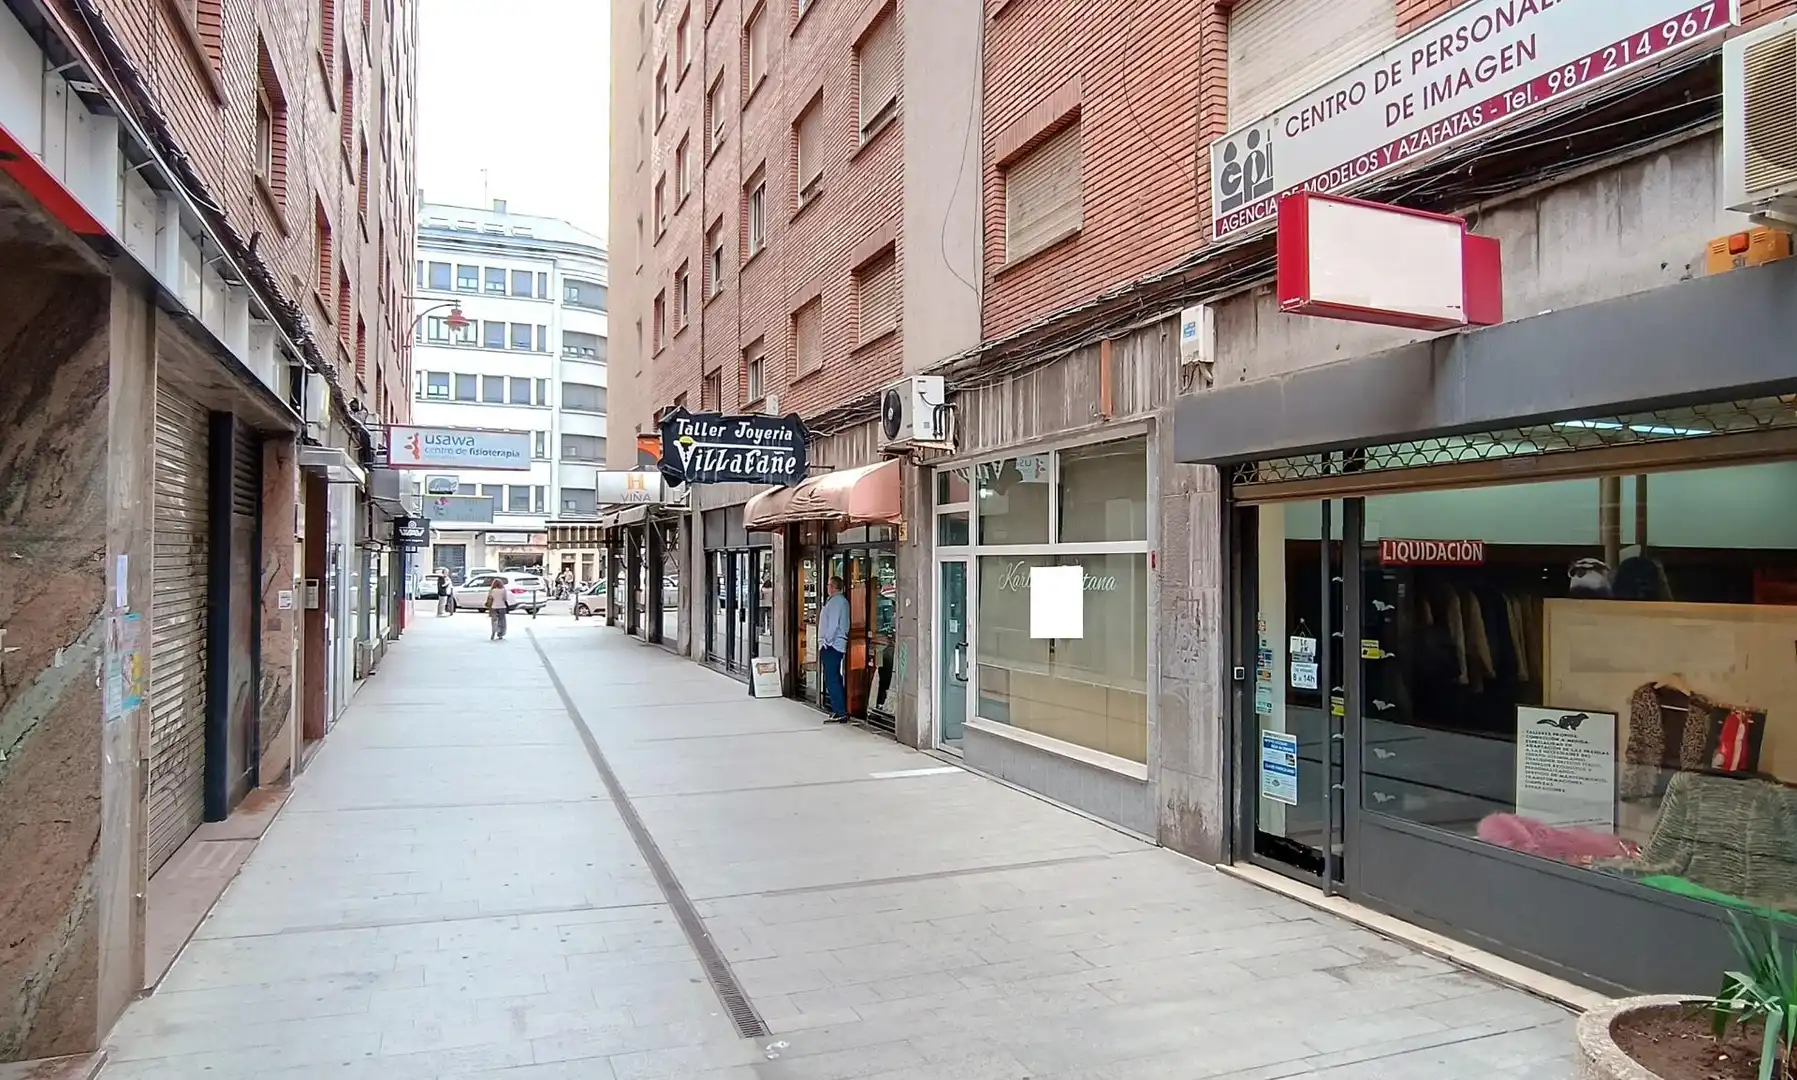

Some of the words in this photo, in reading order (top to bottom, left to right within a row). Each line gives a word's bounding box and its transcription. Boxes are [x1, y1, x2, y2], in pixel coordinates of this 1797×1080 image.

[1386, 93, 1414, 128] DE
[1423, 33, 1536, 110] IMAGEN
[1286, 81, 1366, 137] CENTRO
[1374, 60, 1402, 95] DE
[1220, 200, 1278, 235] AGENCIA
[1303, 153, 1378, 193] MODELOS
[1383, 144, 1394, 164] Y
[1397, 105, 1483, 159] AZAFATAS
[1503, 83, 1539, 113] Tel.
[1547, 56, 1592, 95] 987
[1602, 31, 1652, 72] 214
[1662, 3, 1715, 46] 967
[424, 434, 475, 447] usawa
[676, 418, 727, 437] Taller
[734, 421, 793, 445] Joyeria
[424, 446, 454, 455] centro
[455, 447, 468, 455] de
[469, 447, 520, 458] fisioterapia
[620, 490, 652, 502] VIÑA
[1382, 540, 1483, 562] LIQUIDACIÓN
